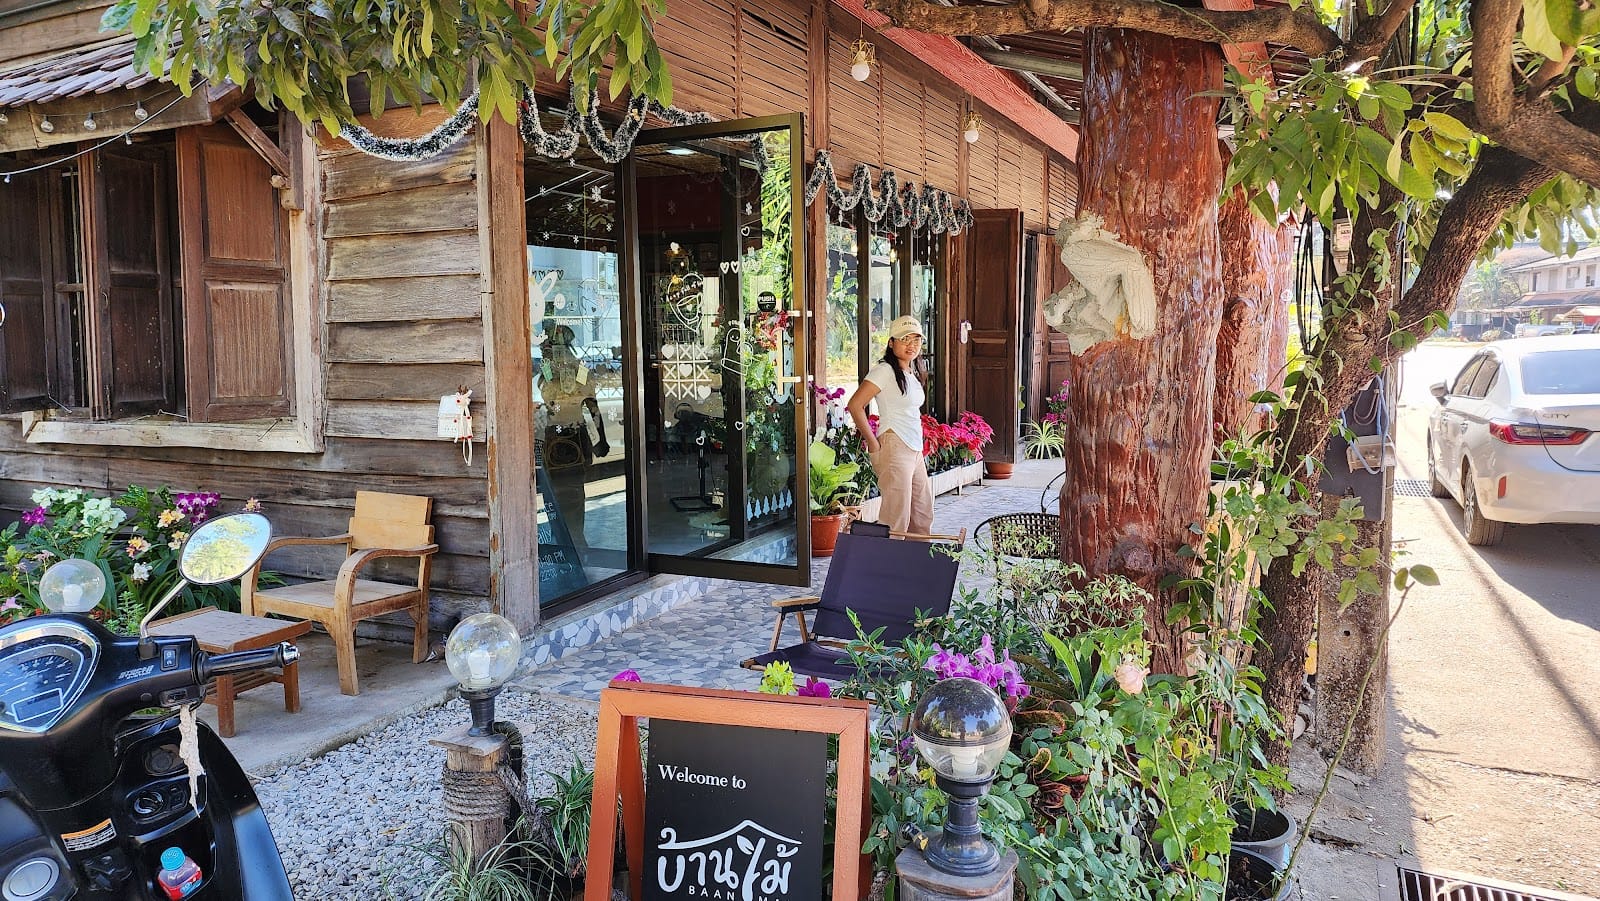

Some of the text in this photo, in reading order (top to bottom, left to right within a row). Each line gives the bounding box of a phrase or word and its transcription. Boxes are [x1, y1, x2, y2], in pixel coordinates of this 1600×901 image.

[658, 764, 746, 789] Welcome to
[657, 820, 802, 901] บ้านไม้
[688, 885, 735, 901] BAAN
